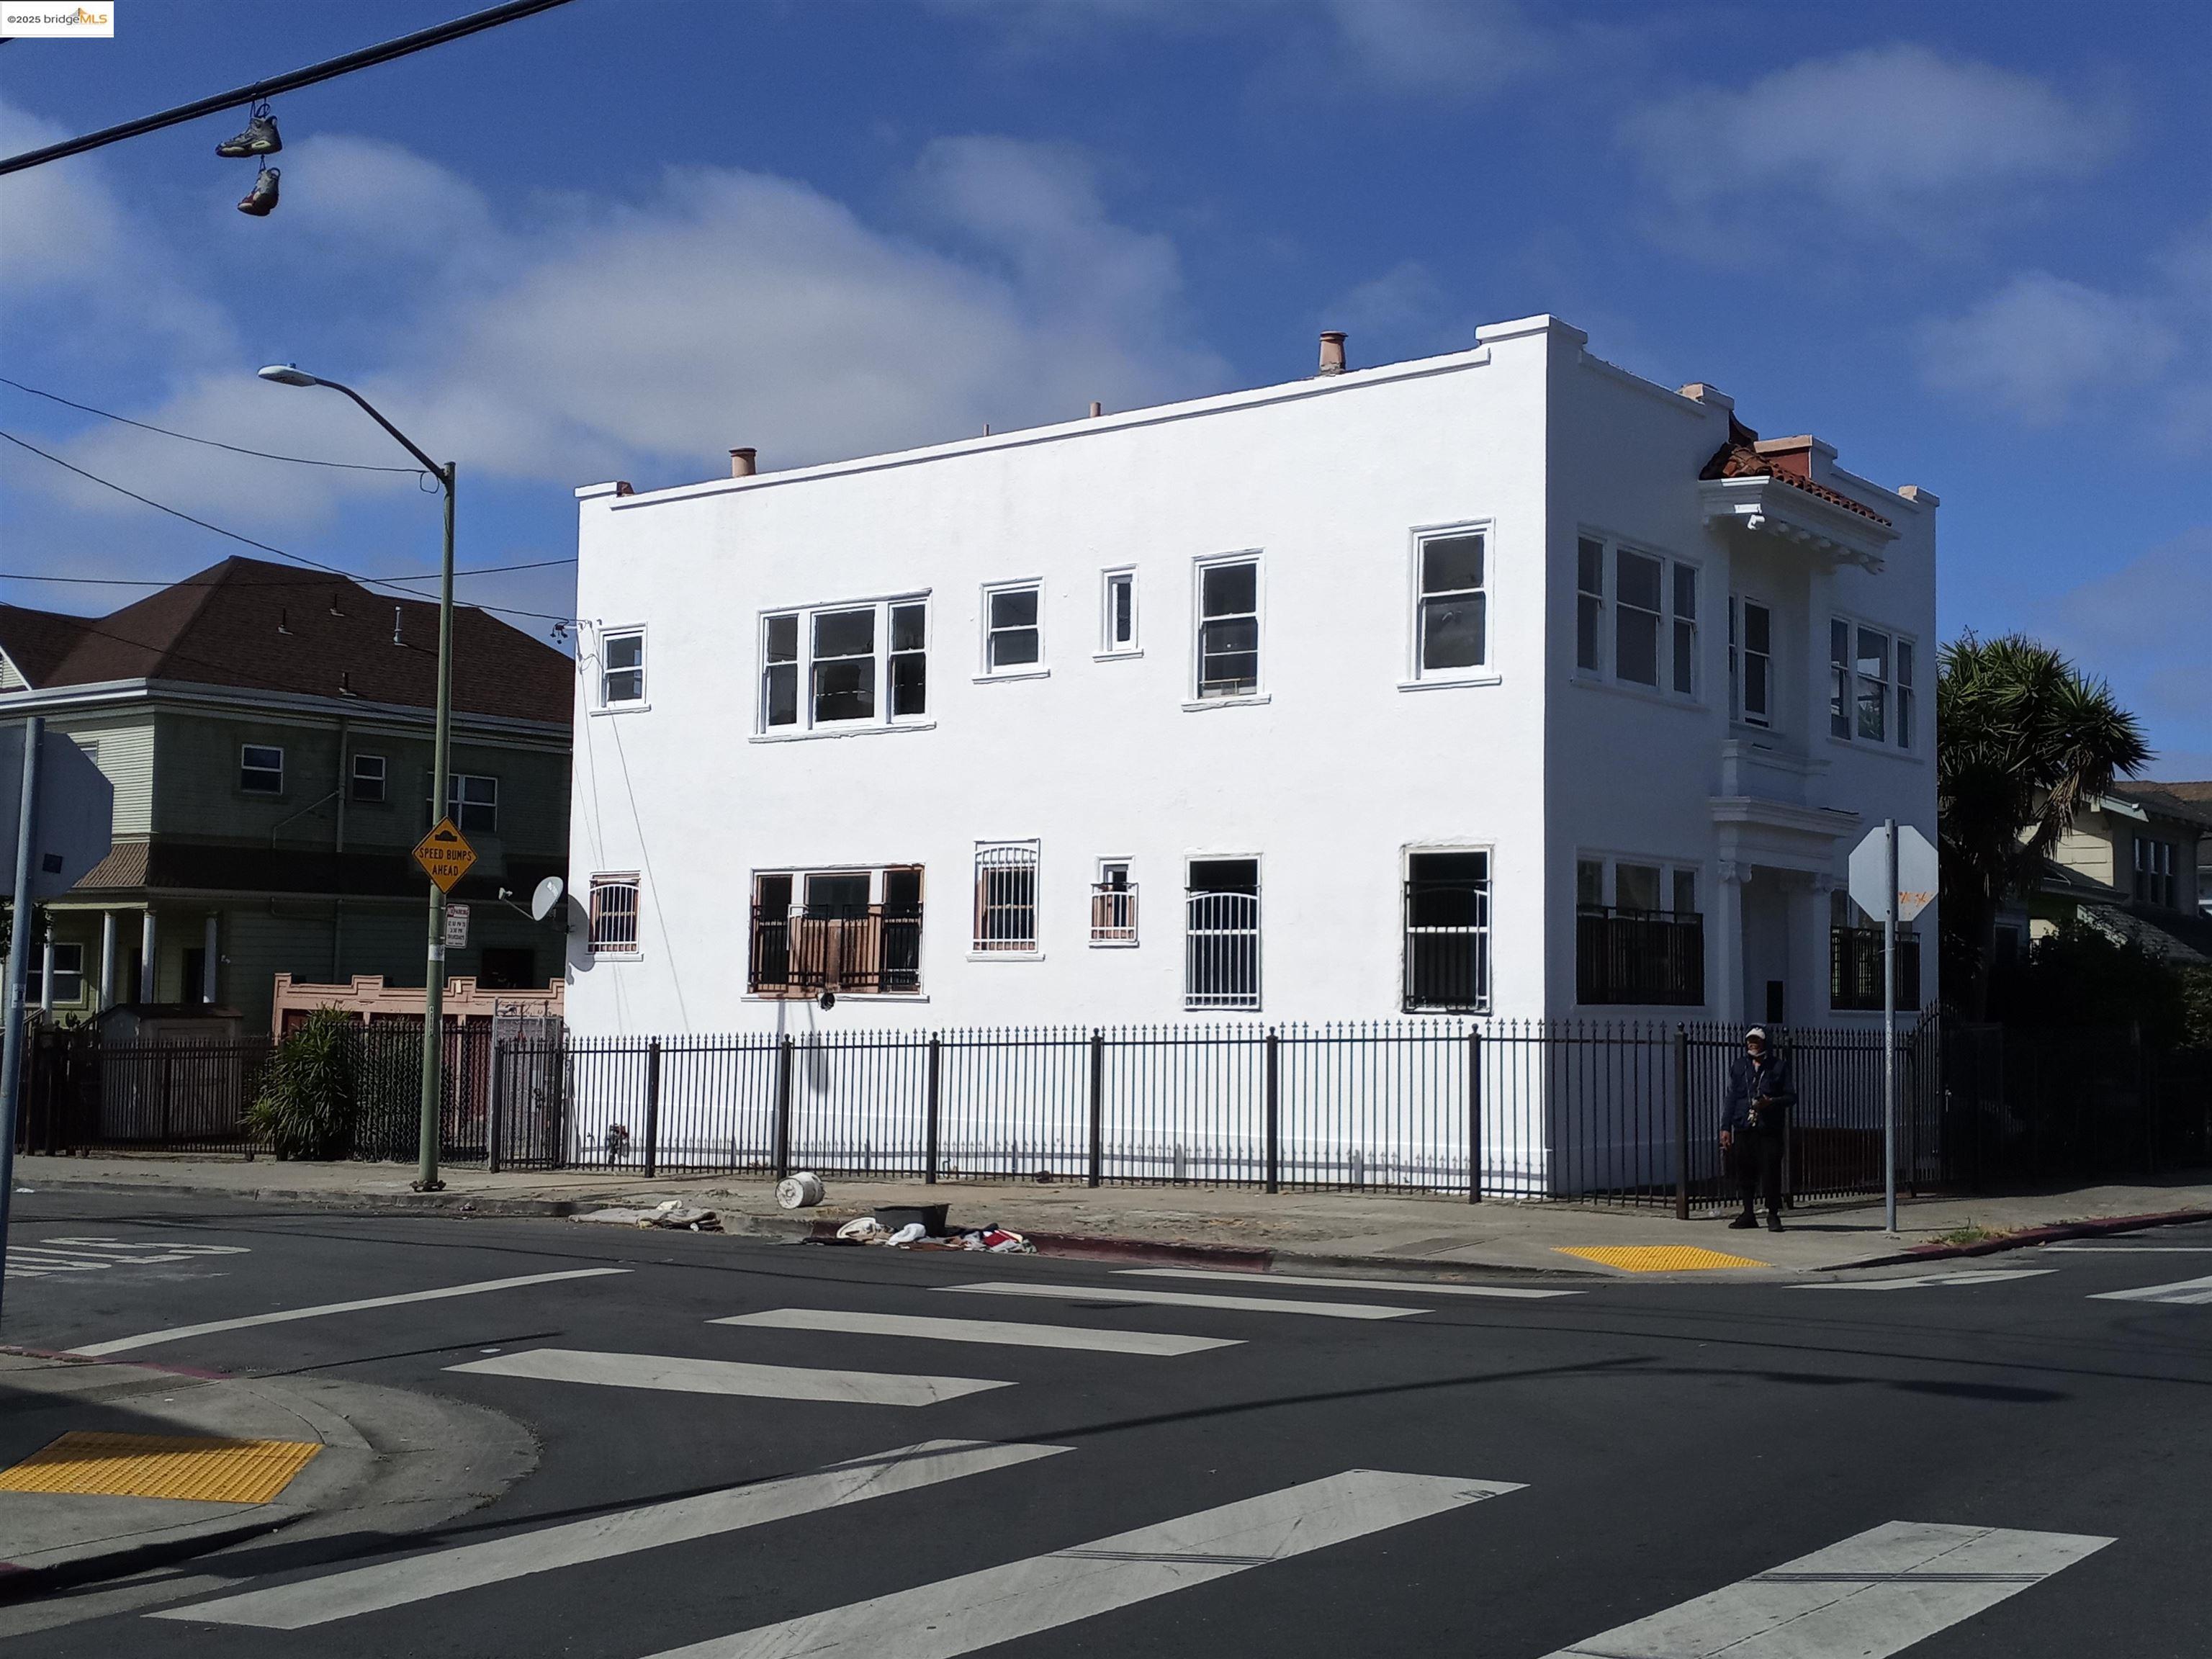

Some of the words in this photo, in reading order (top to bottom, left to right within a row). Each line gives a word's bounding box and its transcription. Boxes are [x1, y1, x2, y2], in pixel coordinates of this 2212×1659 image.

[419, 848, 444, 860] SPEED
[446, 850, 472, 861] BUMPS
[432, 865, 459, 876] AHEAD
